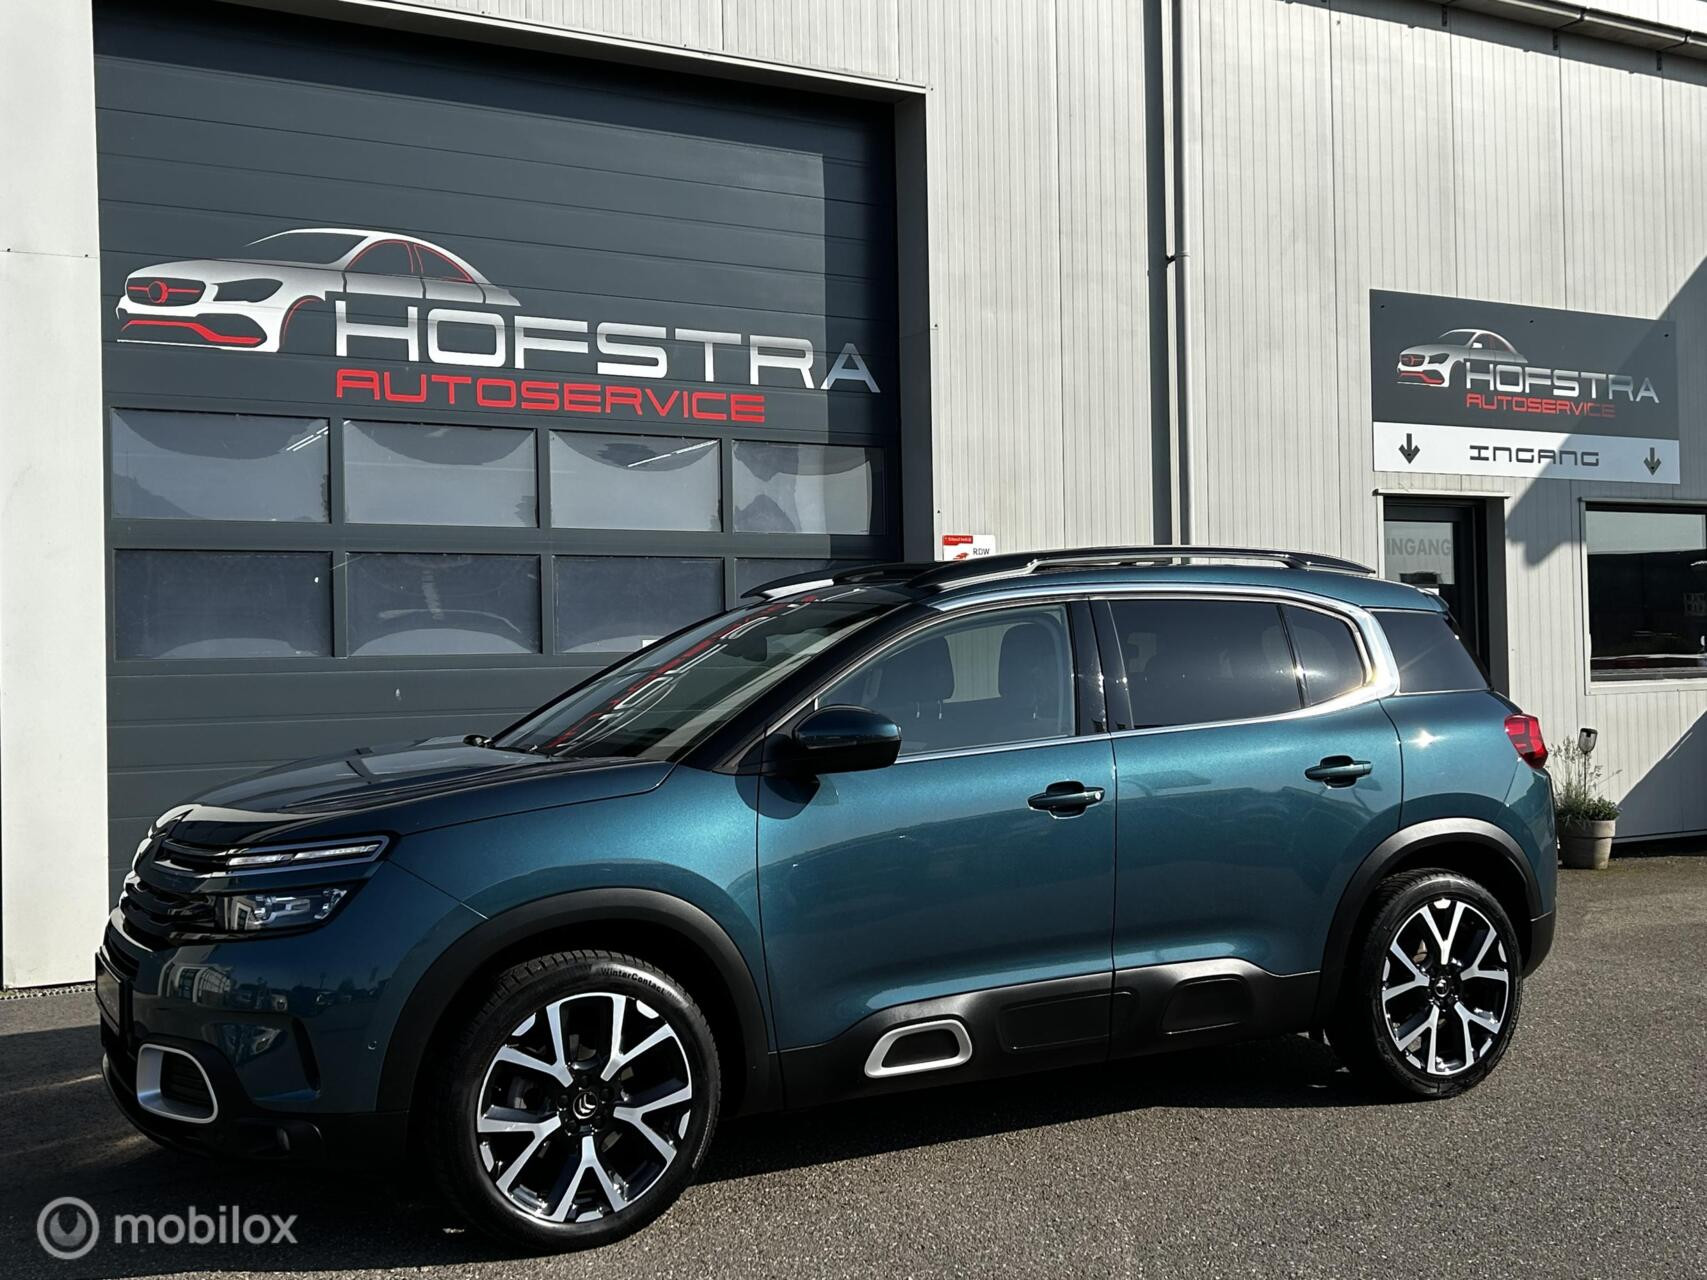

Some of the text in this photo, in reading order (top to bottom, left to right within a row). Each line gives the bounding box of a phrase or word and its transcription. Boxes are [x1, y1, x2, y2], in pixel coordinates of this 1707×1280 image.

[335, 300, 881, 393] HOFSTRA
[336, 368, 766, 423] AUTOSERVICE
[1466, 361, 1659, 404] HOFSTRA
[1466, 392, 1616, 418] AUTOSERVICE
[1469, 444, 1600, 467] INGANG
[972, 547, 990, 556] RDW
[1386, 537, 1452, 556] INGANG
[600, 967, 665, 993] WinterContact
